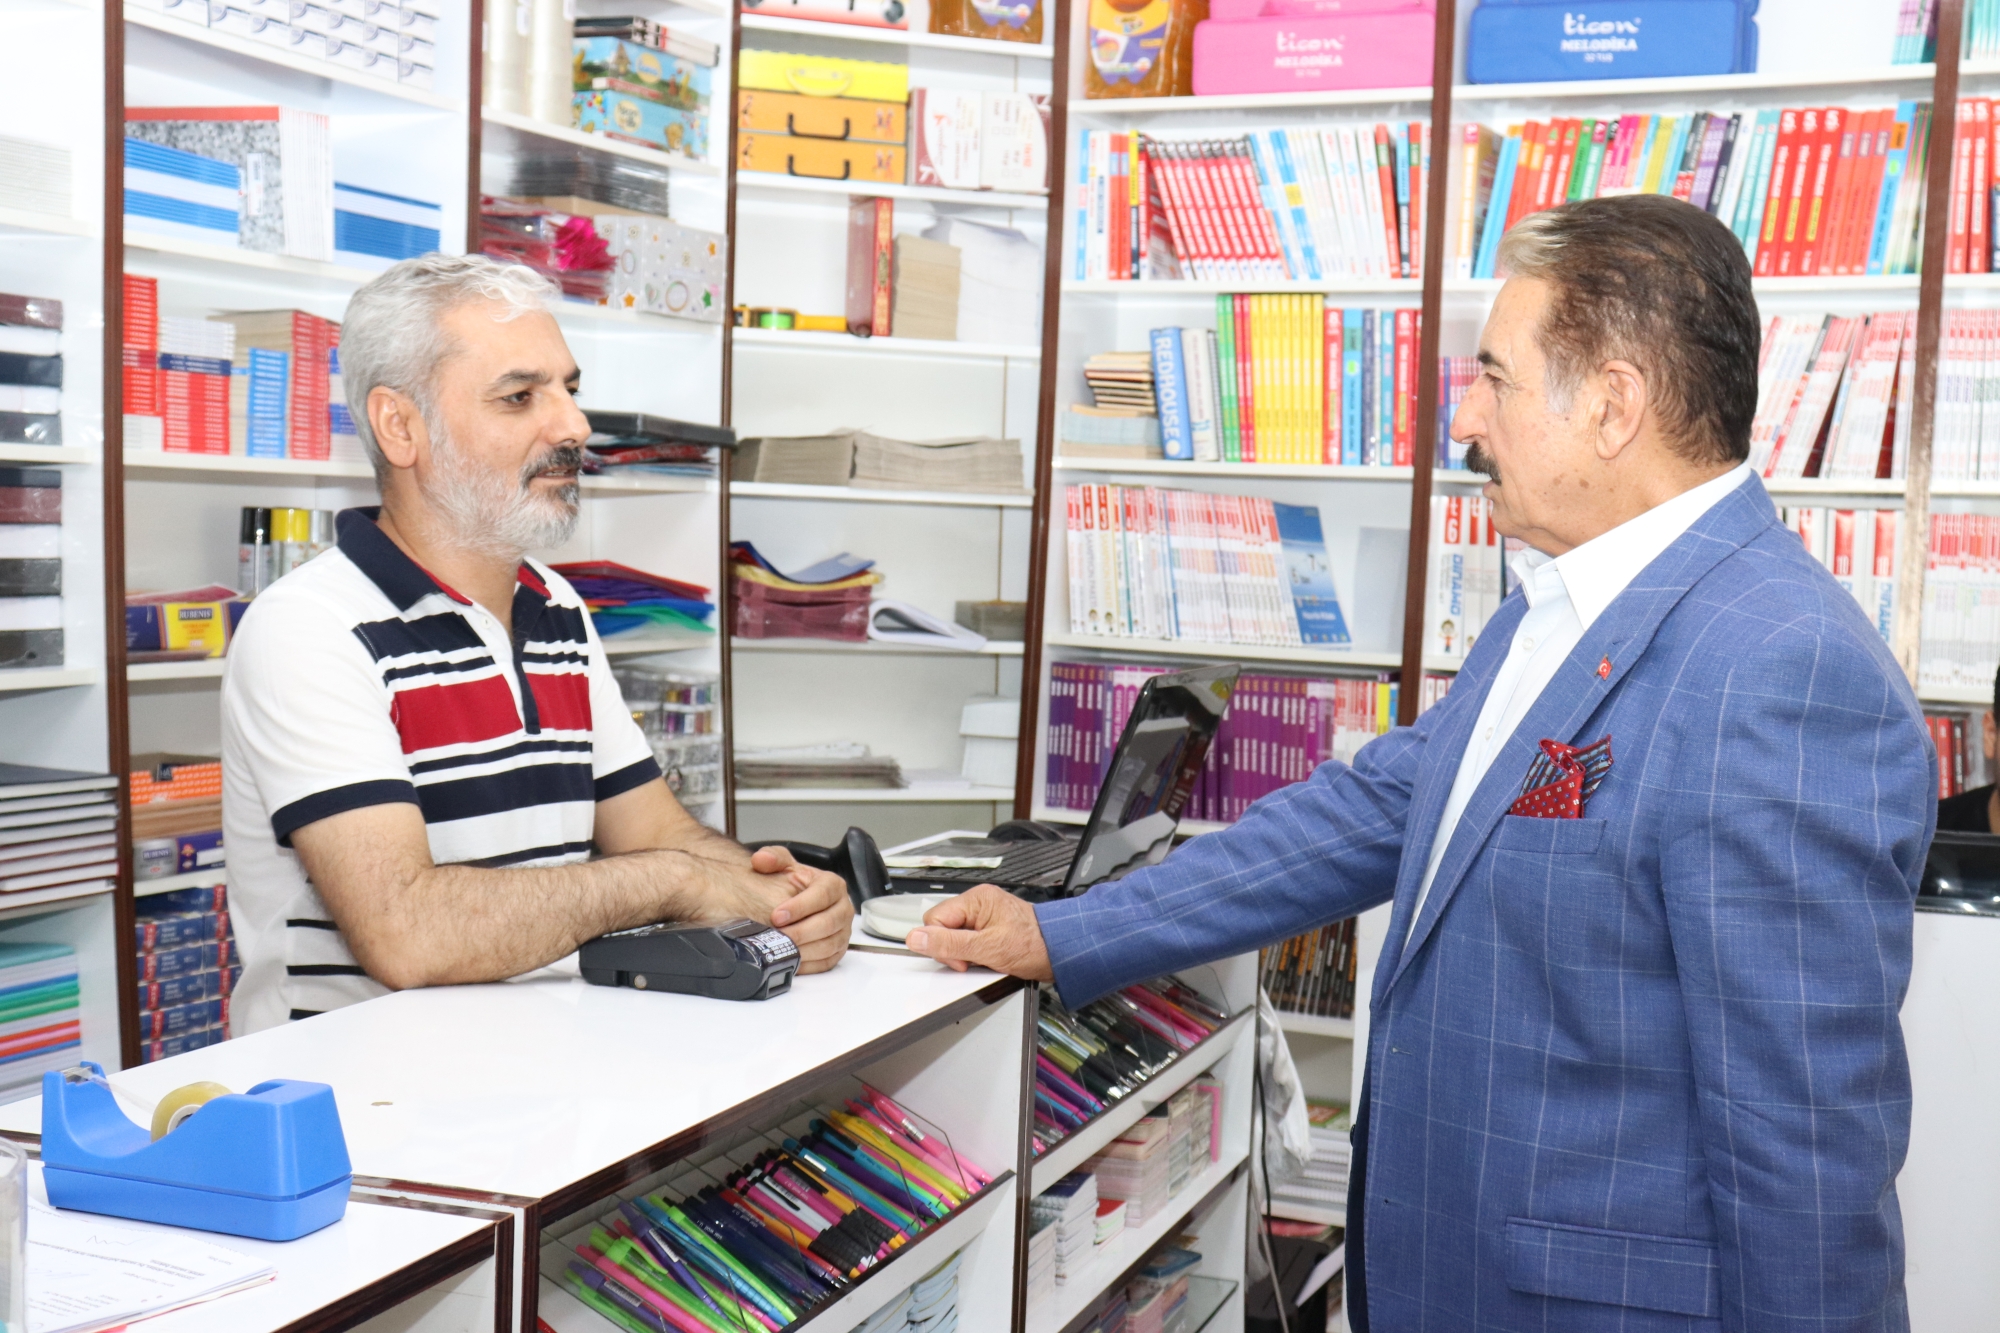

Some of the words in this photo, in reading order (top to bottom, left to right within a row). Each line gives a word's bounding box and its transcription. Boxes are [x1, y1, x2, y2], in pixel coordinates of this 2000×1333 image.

[1563, 12, 1639, 35] ticon
[1277, 31, 1343, 52] ticon
[1560, 36, 1638, 52] MELODİKA
[1154, 336, 1181, 440] REDHOUSE
[1446, 517, 1459, 544] 6
[179, 609, 212, 619] RUBENIS
